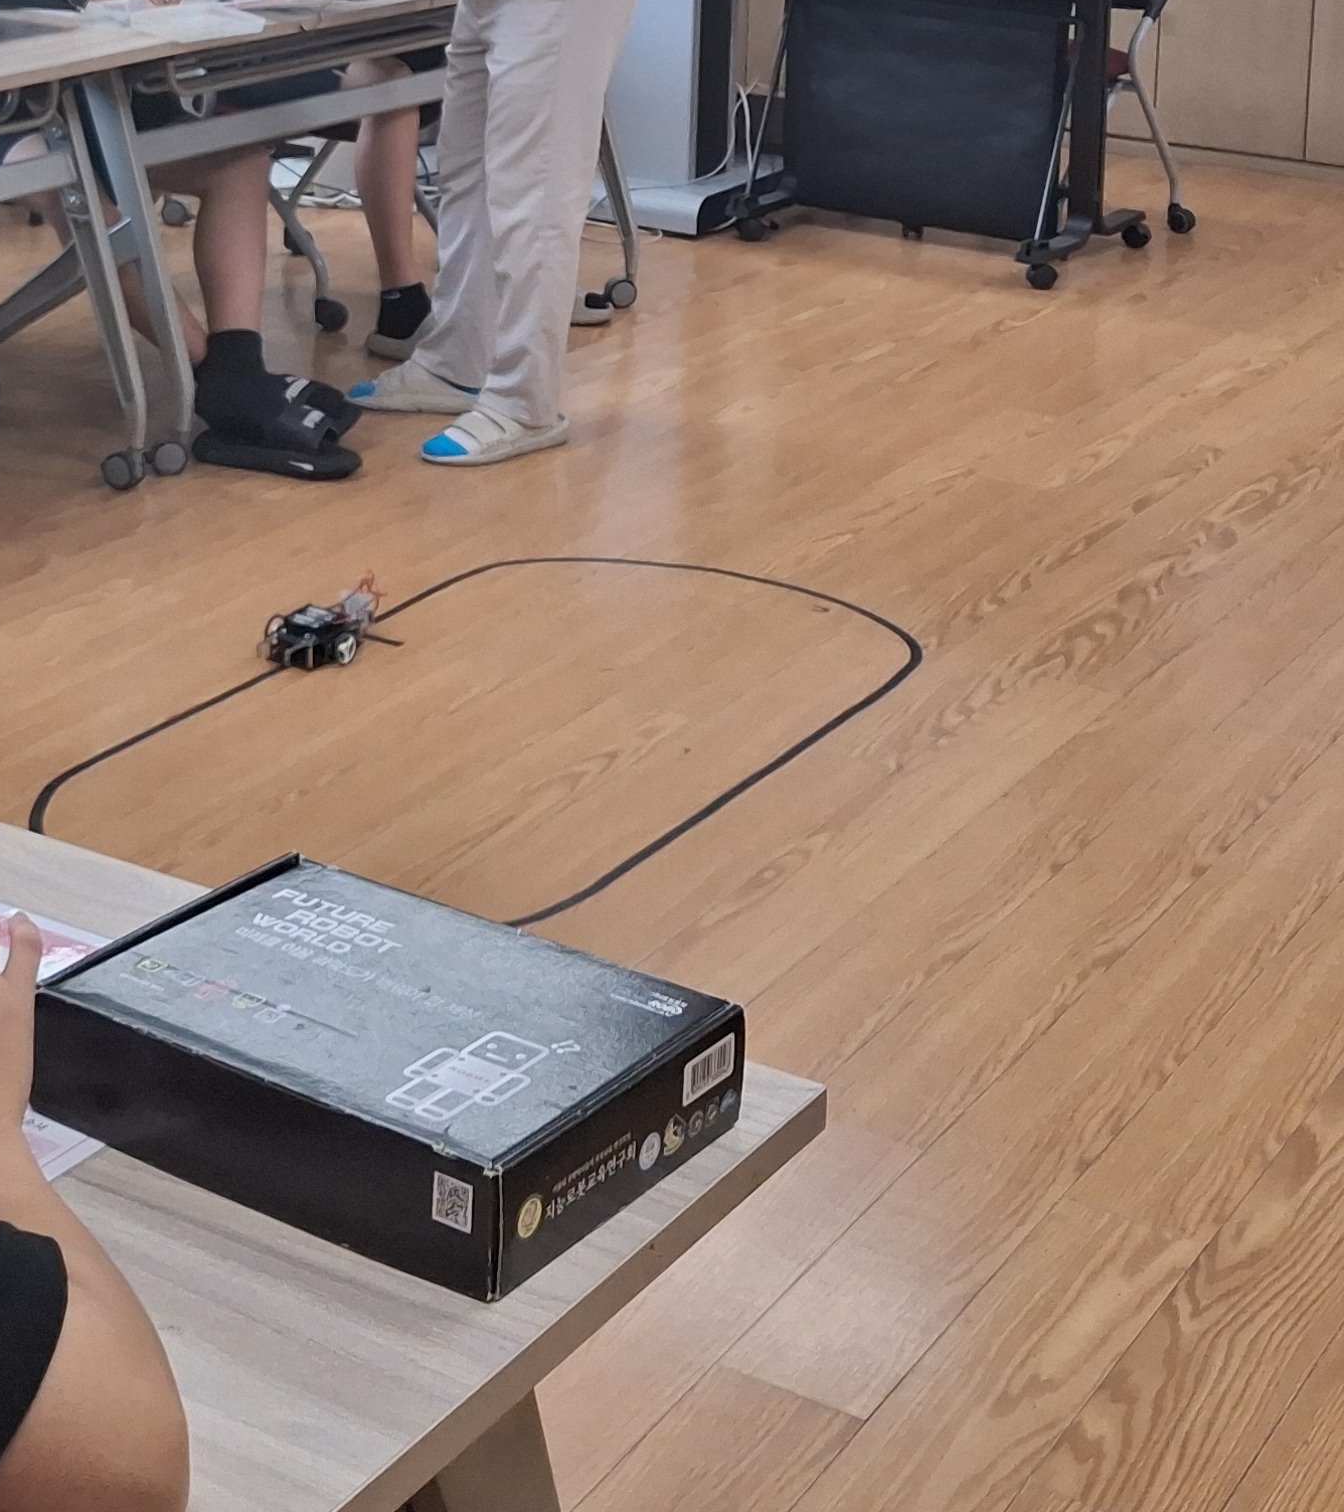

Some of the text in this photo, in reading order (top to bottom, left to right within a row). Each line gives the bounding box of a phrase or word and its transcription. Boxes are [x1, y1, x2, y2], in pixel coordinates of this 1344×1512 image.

[251, 912, 353, 955] WORLD
[271, 888, 396, 934] FUTURE
[284, 909, 404, 955] ROBOT
